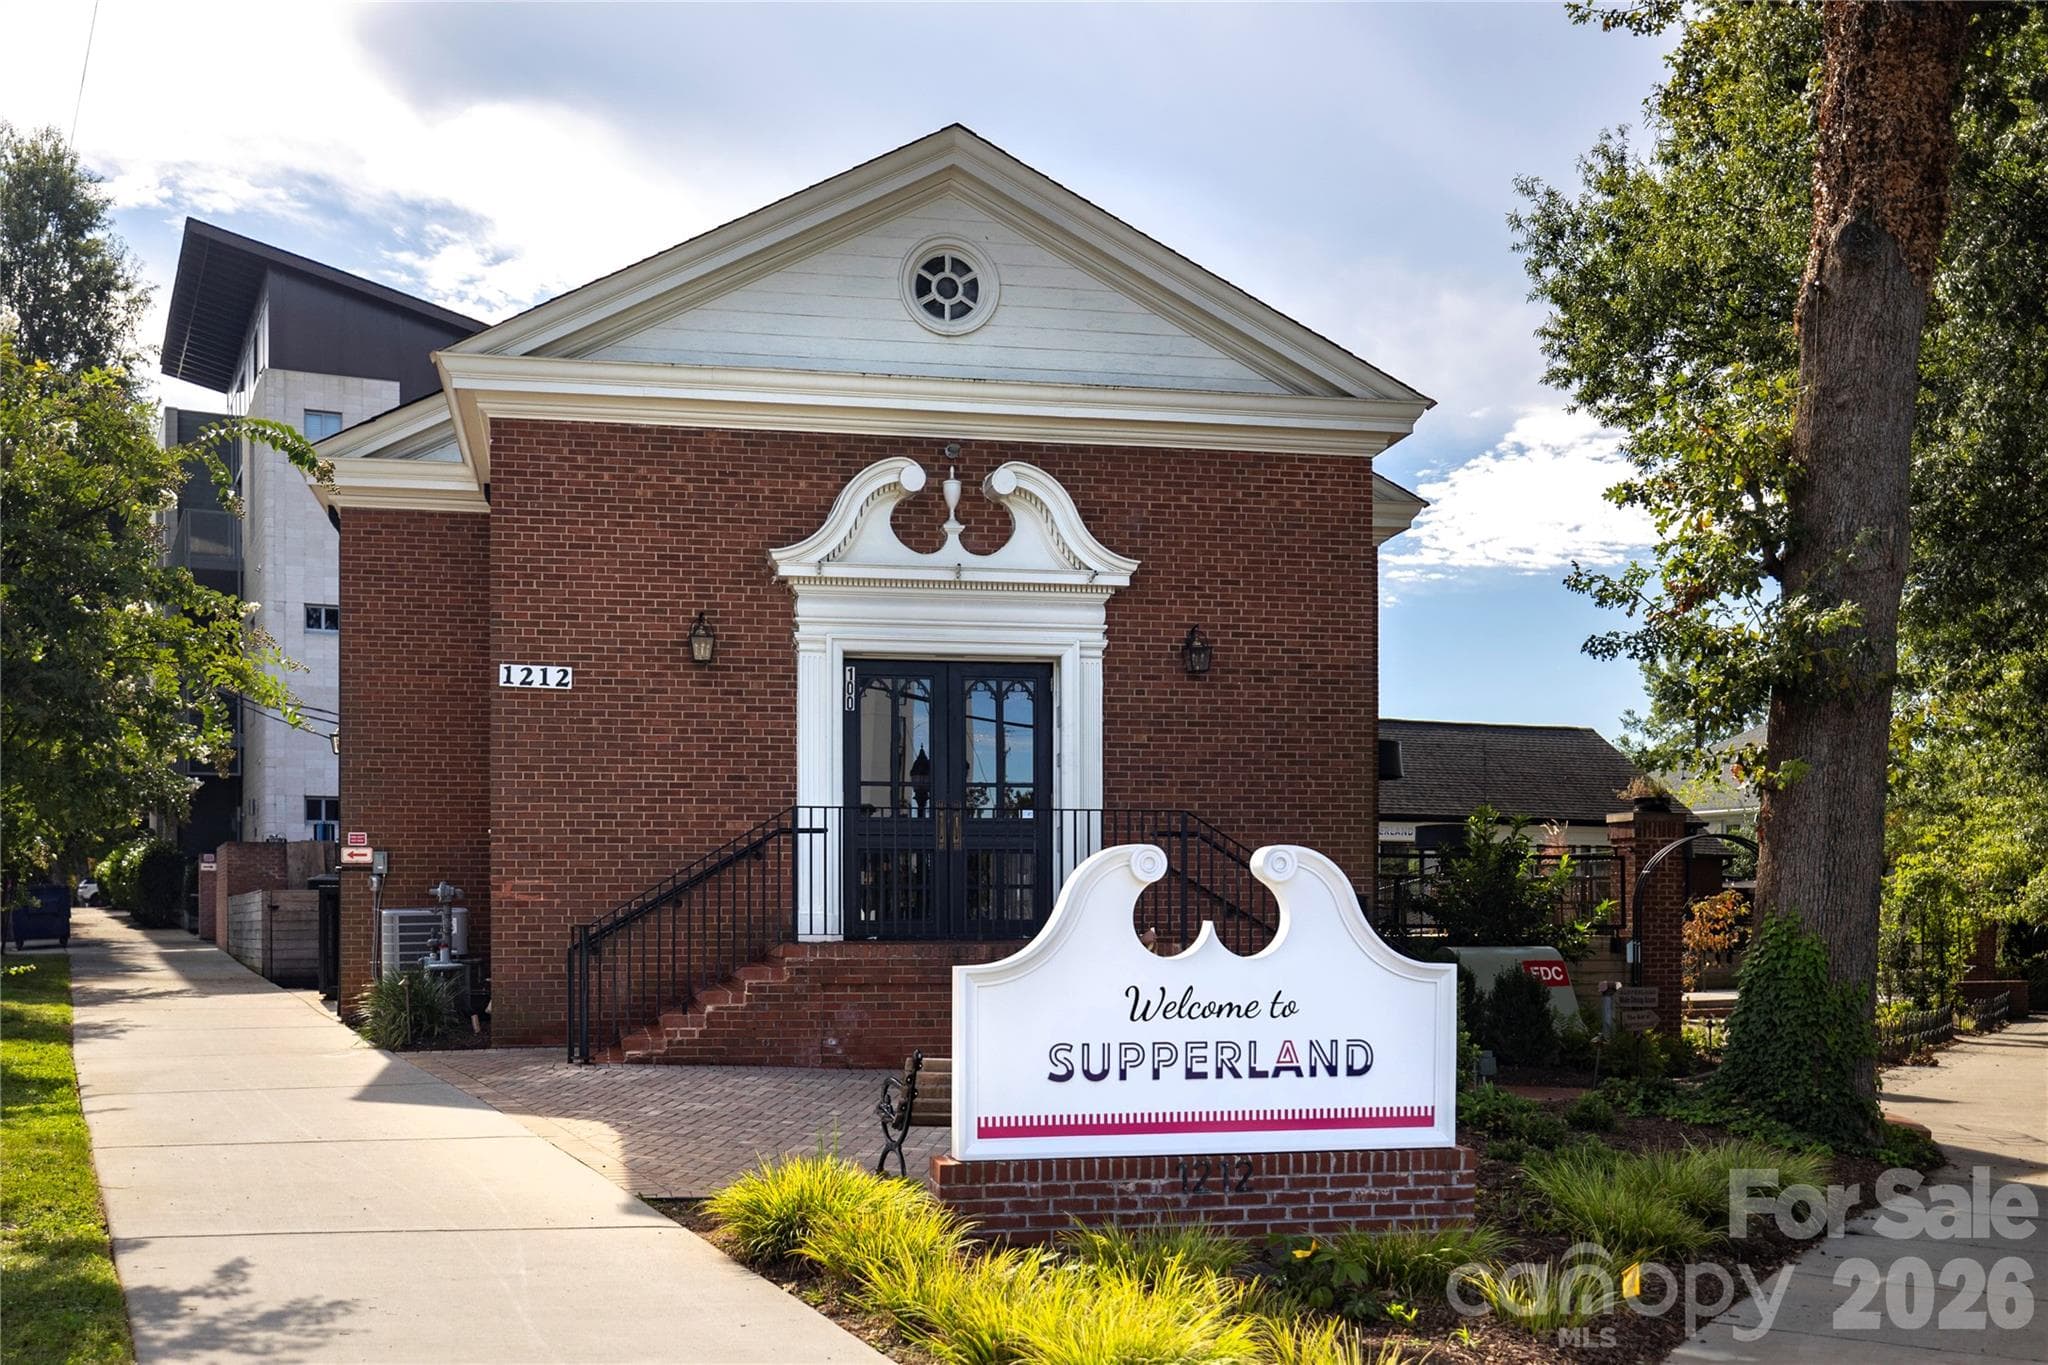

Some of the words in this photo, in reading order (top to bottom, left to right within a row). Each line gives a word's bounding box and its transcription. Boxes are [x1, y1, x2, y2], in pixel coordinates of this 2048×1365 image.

[502, 665, 570, 688] 1212
[846, 667, 854, 710] 100
[1530, 966, 1564, 981] FDC
[1124, 985, 1262, 1022] Welcome
[1269, 989, 1300, 1019] to
[1048, 1039, 1375, 1083] SUPPERLAND
[1176, 1156, 1254, 1195] 1212
